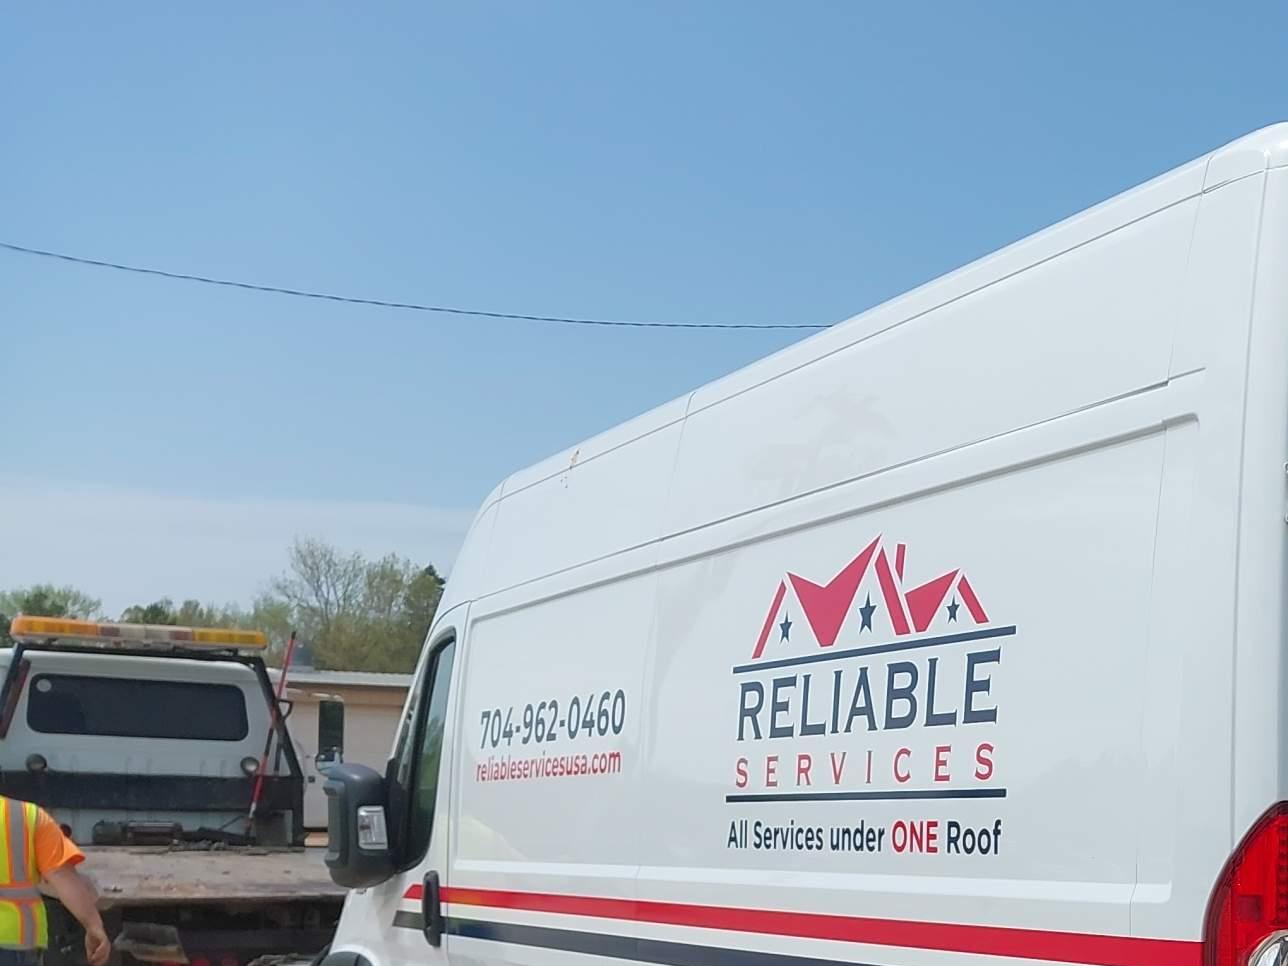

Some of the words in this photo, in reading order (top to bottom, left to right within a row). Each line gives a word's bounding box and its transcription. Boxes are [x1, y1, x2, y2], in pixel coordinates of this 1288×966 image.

[736, 647, 1001, 742] RELIABLE
[479, 688, 626, 750] 704-962-0460
[475, 749, 622, 783] reliableservicesusa.com
[735, 742, 995, 790] SERVICES
[727, 820, 749, 850] All
[752, 820, 824, 853] Services
[829, 821, 885, 854] under
[891, 820, 939, 855] ONE
[946, 819, 1002, 857] Roof
